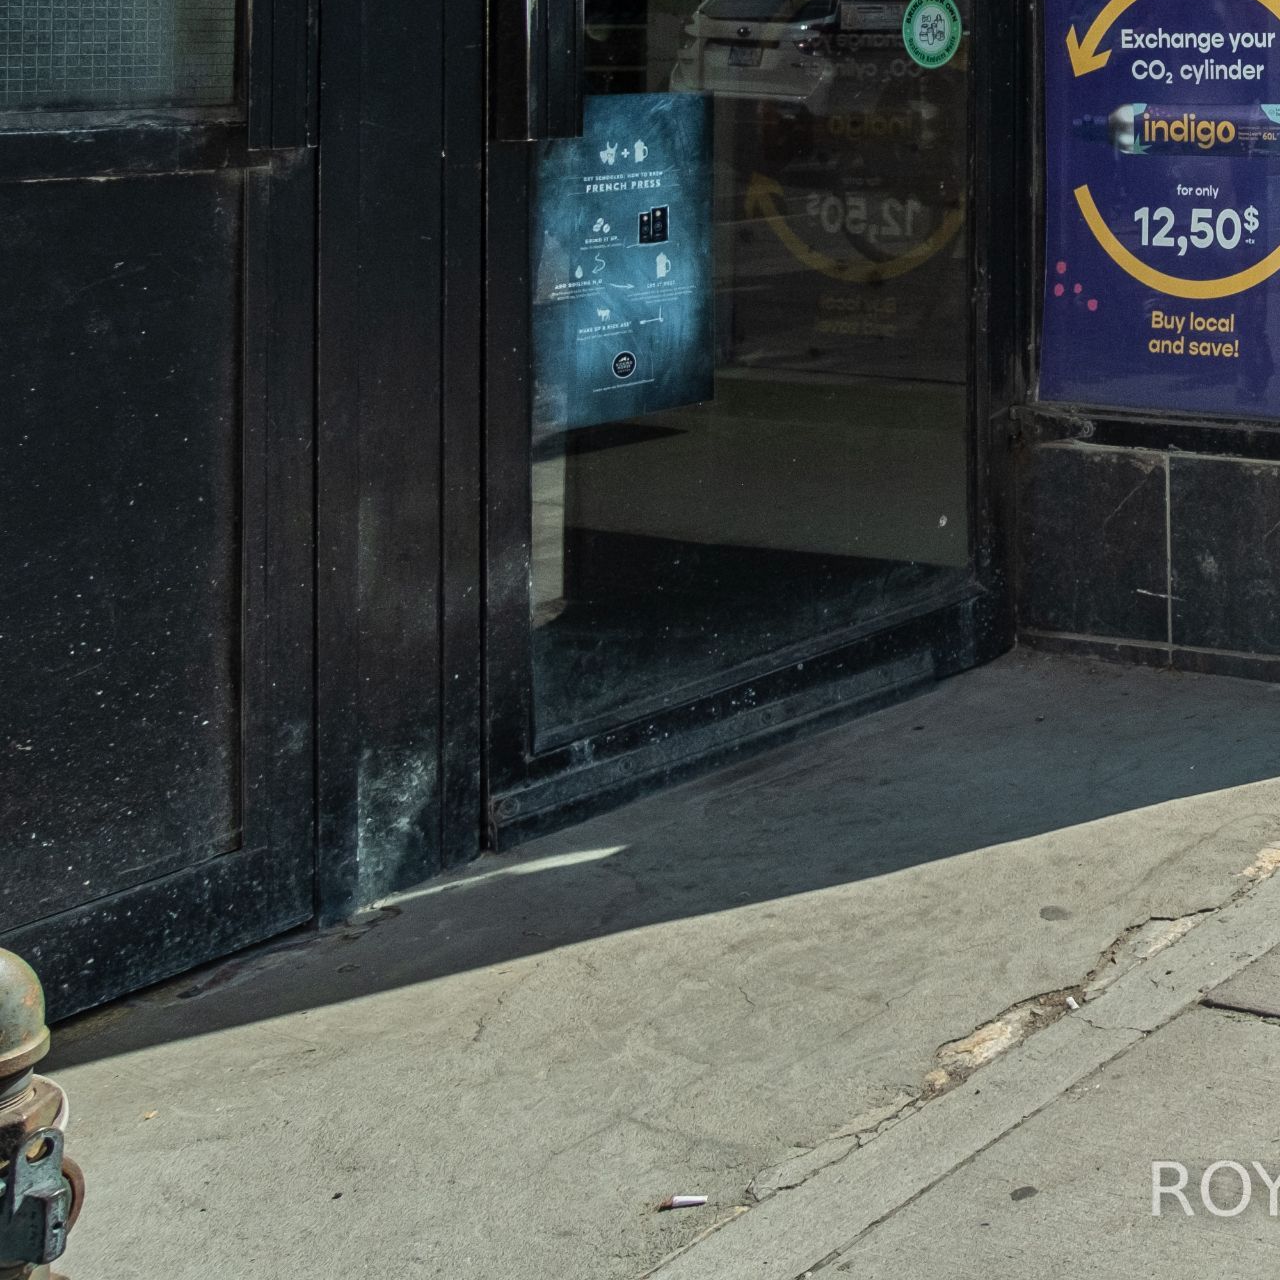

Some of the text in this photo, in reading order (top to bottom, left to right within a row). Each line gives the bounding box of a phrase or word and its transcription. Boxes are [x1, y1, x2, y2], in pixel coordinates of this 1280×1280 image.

[906, 0, 923, 24] BRING
[945, 2, 958, 22] OWN
[1121, 28, 1276, 53] Exchange your
[1180, 59, 1265, 84] cylinder
[1143, 112, 1236, 149] indigo
[586, 179, 661, 193] FRENCH PRESS
[1177, 184, 1219, 199] for only
[1151, 311, 1235, 334] Buy local
[1148, 336, 1240, 358] and save!
